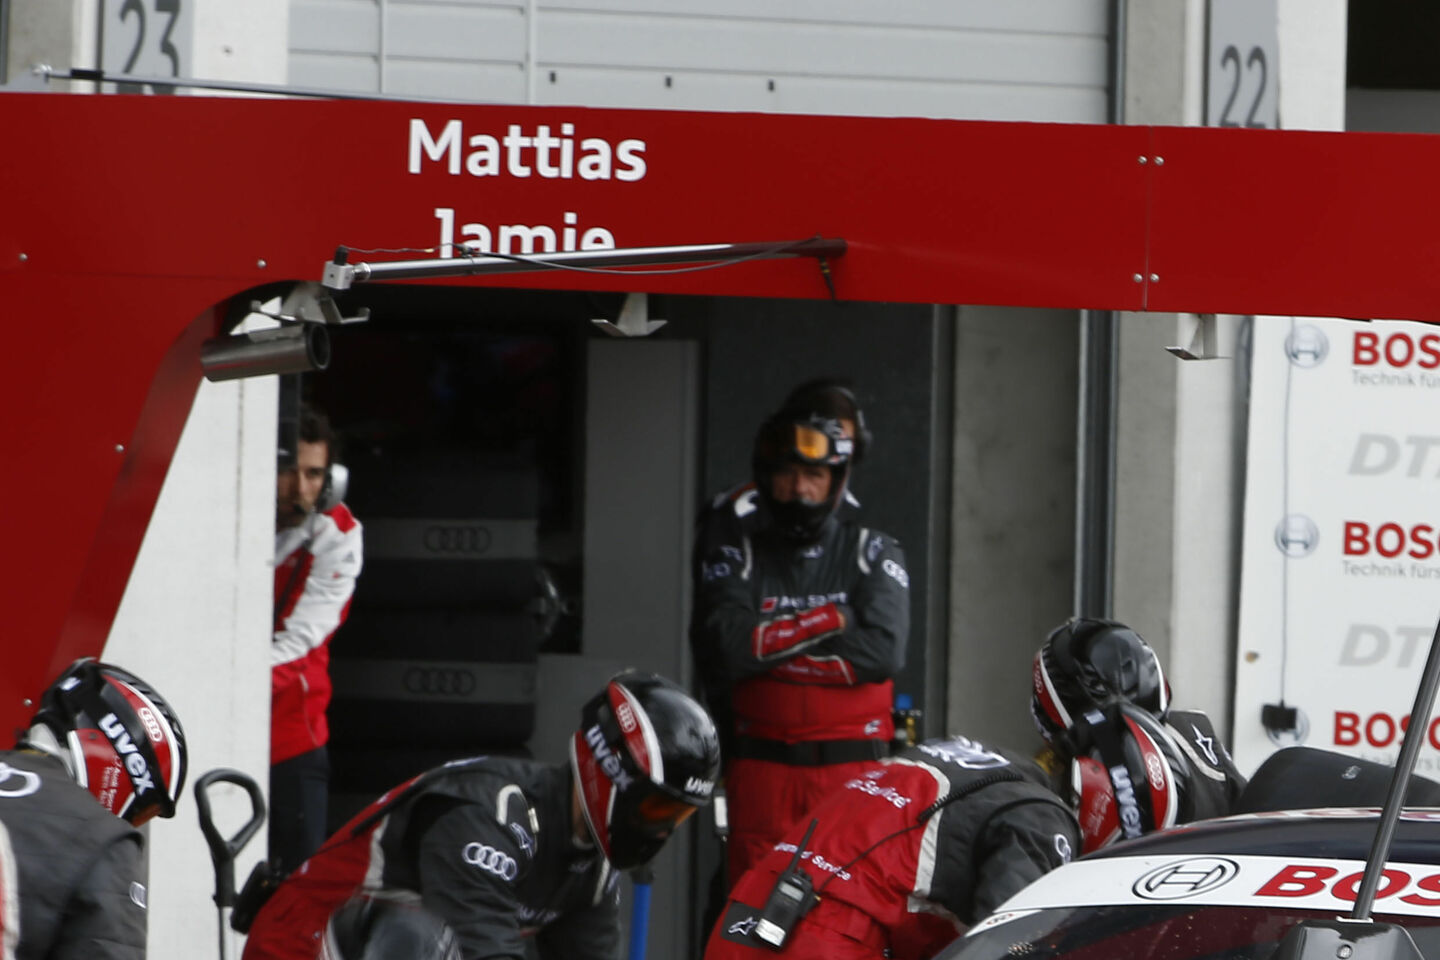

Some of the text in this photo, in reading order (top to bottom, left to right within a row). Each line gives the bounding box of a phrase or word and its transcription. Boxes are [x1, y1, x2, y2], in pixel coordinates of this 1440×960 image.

[116, 0, 181, 95] 23
[1219, 45, 1267, 128] 22
[408, 118, 647, 181] Mattias
[434, 207, 617, 259] Jamie
[1352, 369, 1415, 387] Technik
[97, 711, 156, 797] uvex
[585, 724, 634, 792] uvex
[1110, 764, 1142, 838] uvex
